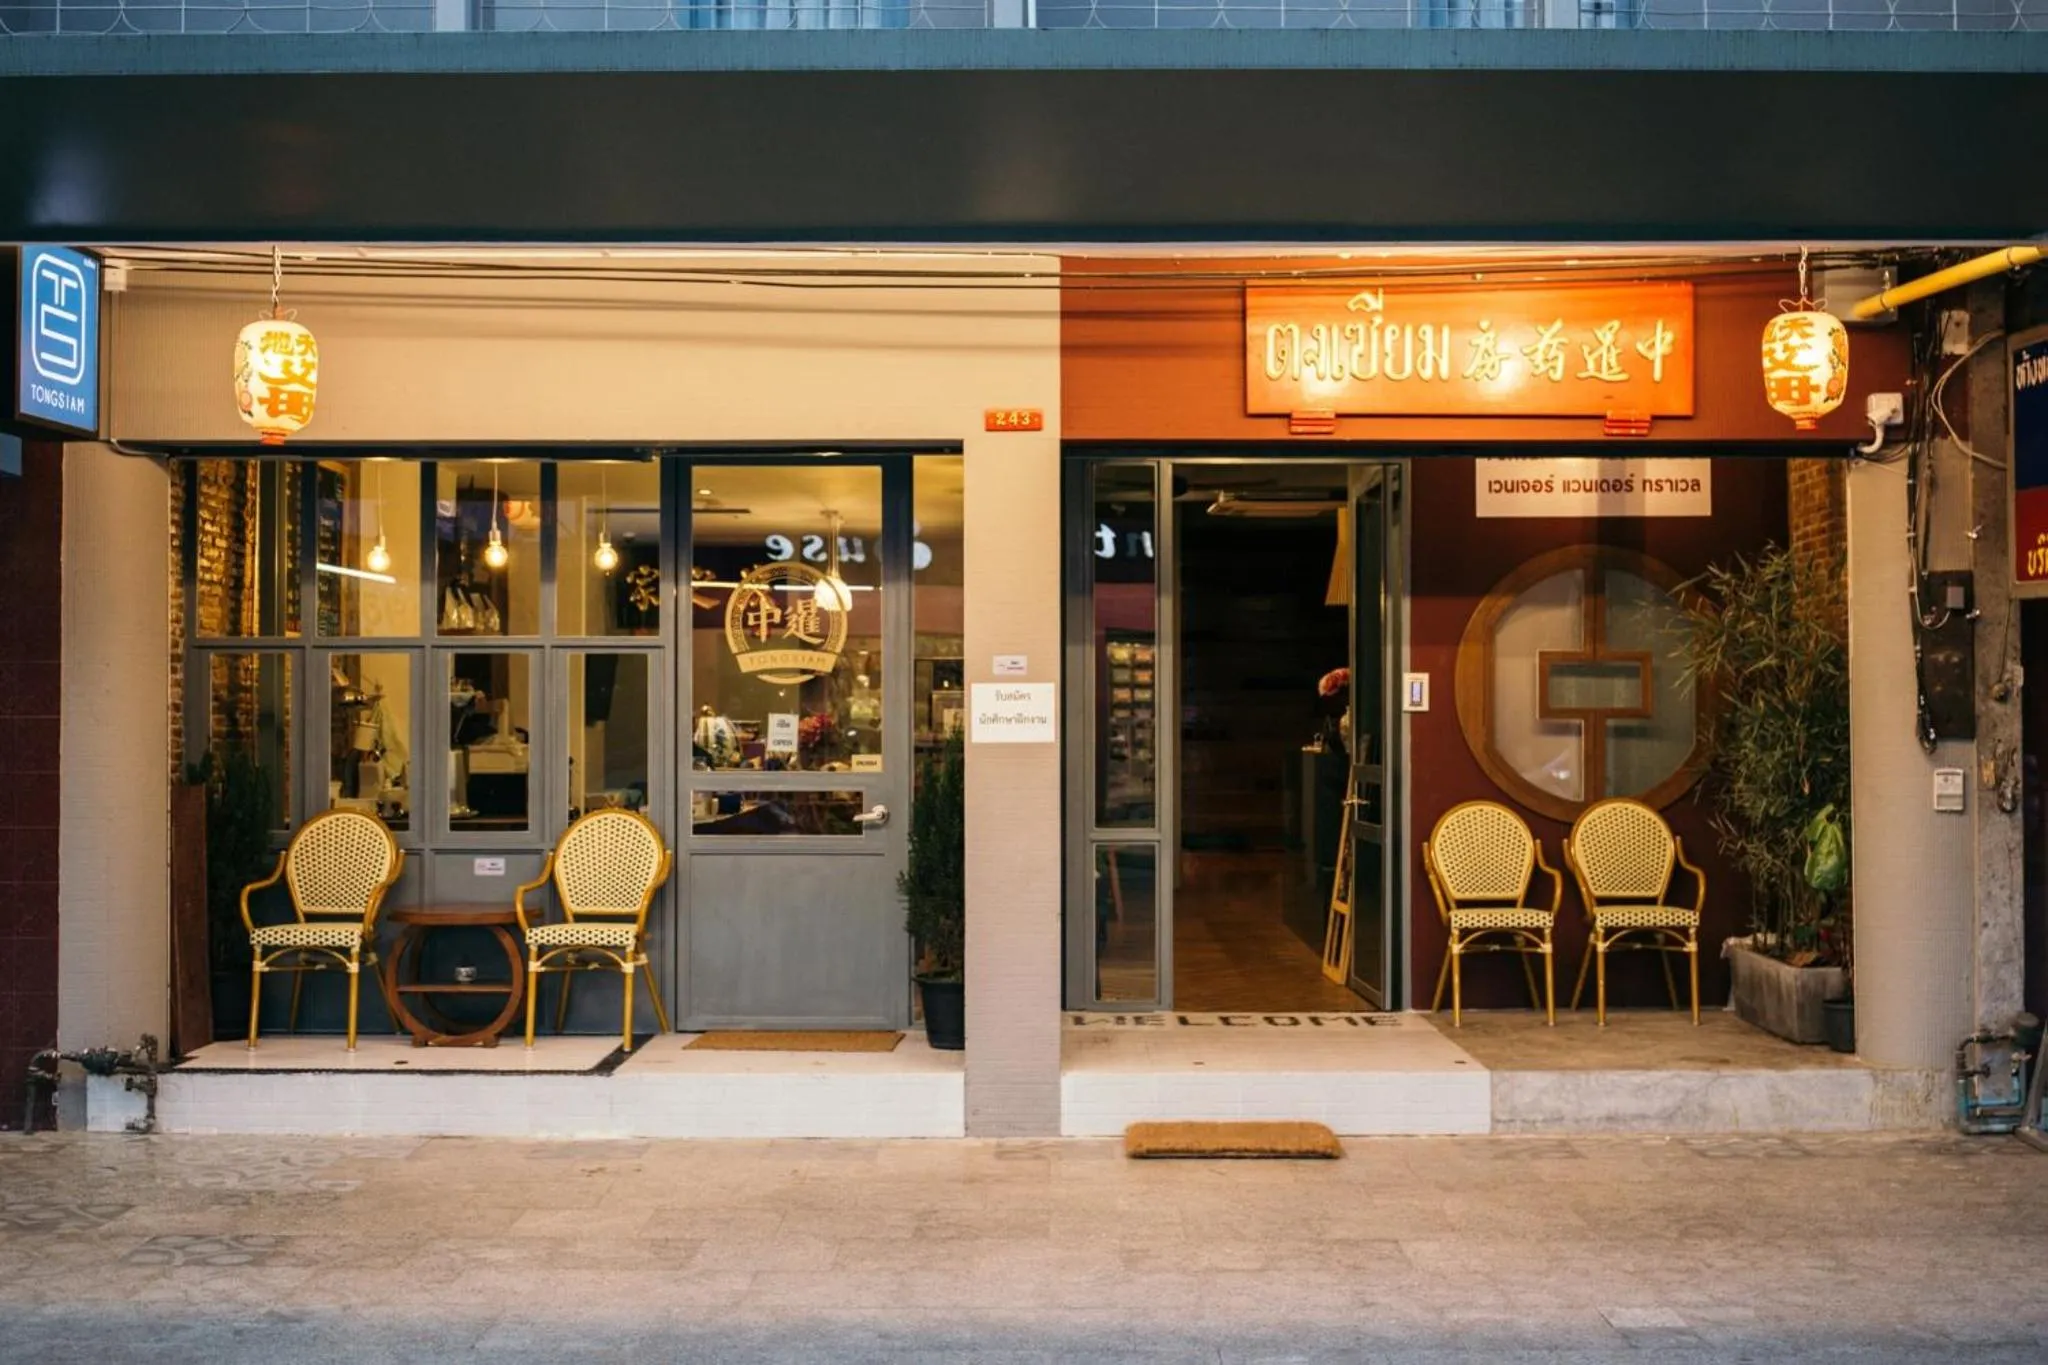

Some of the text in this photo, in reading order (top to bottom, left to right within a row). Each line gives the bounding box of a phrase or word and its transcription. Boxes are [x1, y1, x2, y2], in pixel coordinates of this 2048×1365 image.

[31, 384, 85, 413] TONGSIAM
[996, 411, 1030, 426] 243
[1488, 473, 1554, 493] เวนเจอร์
